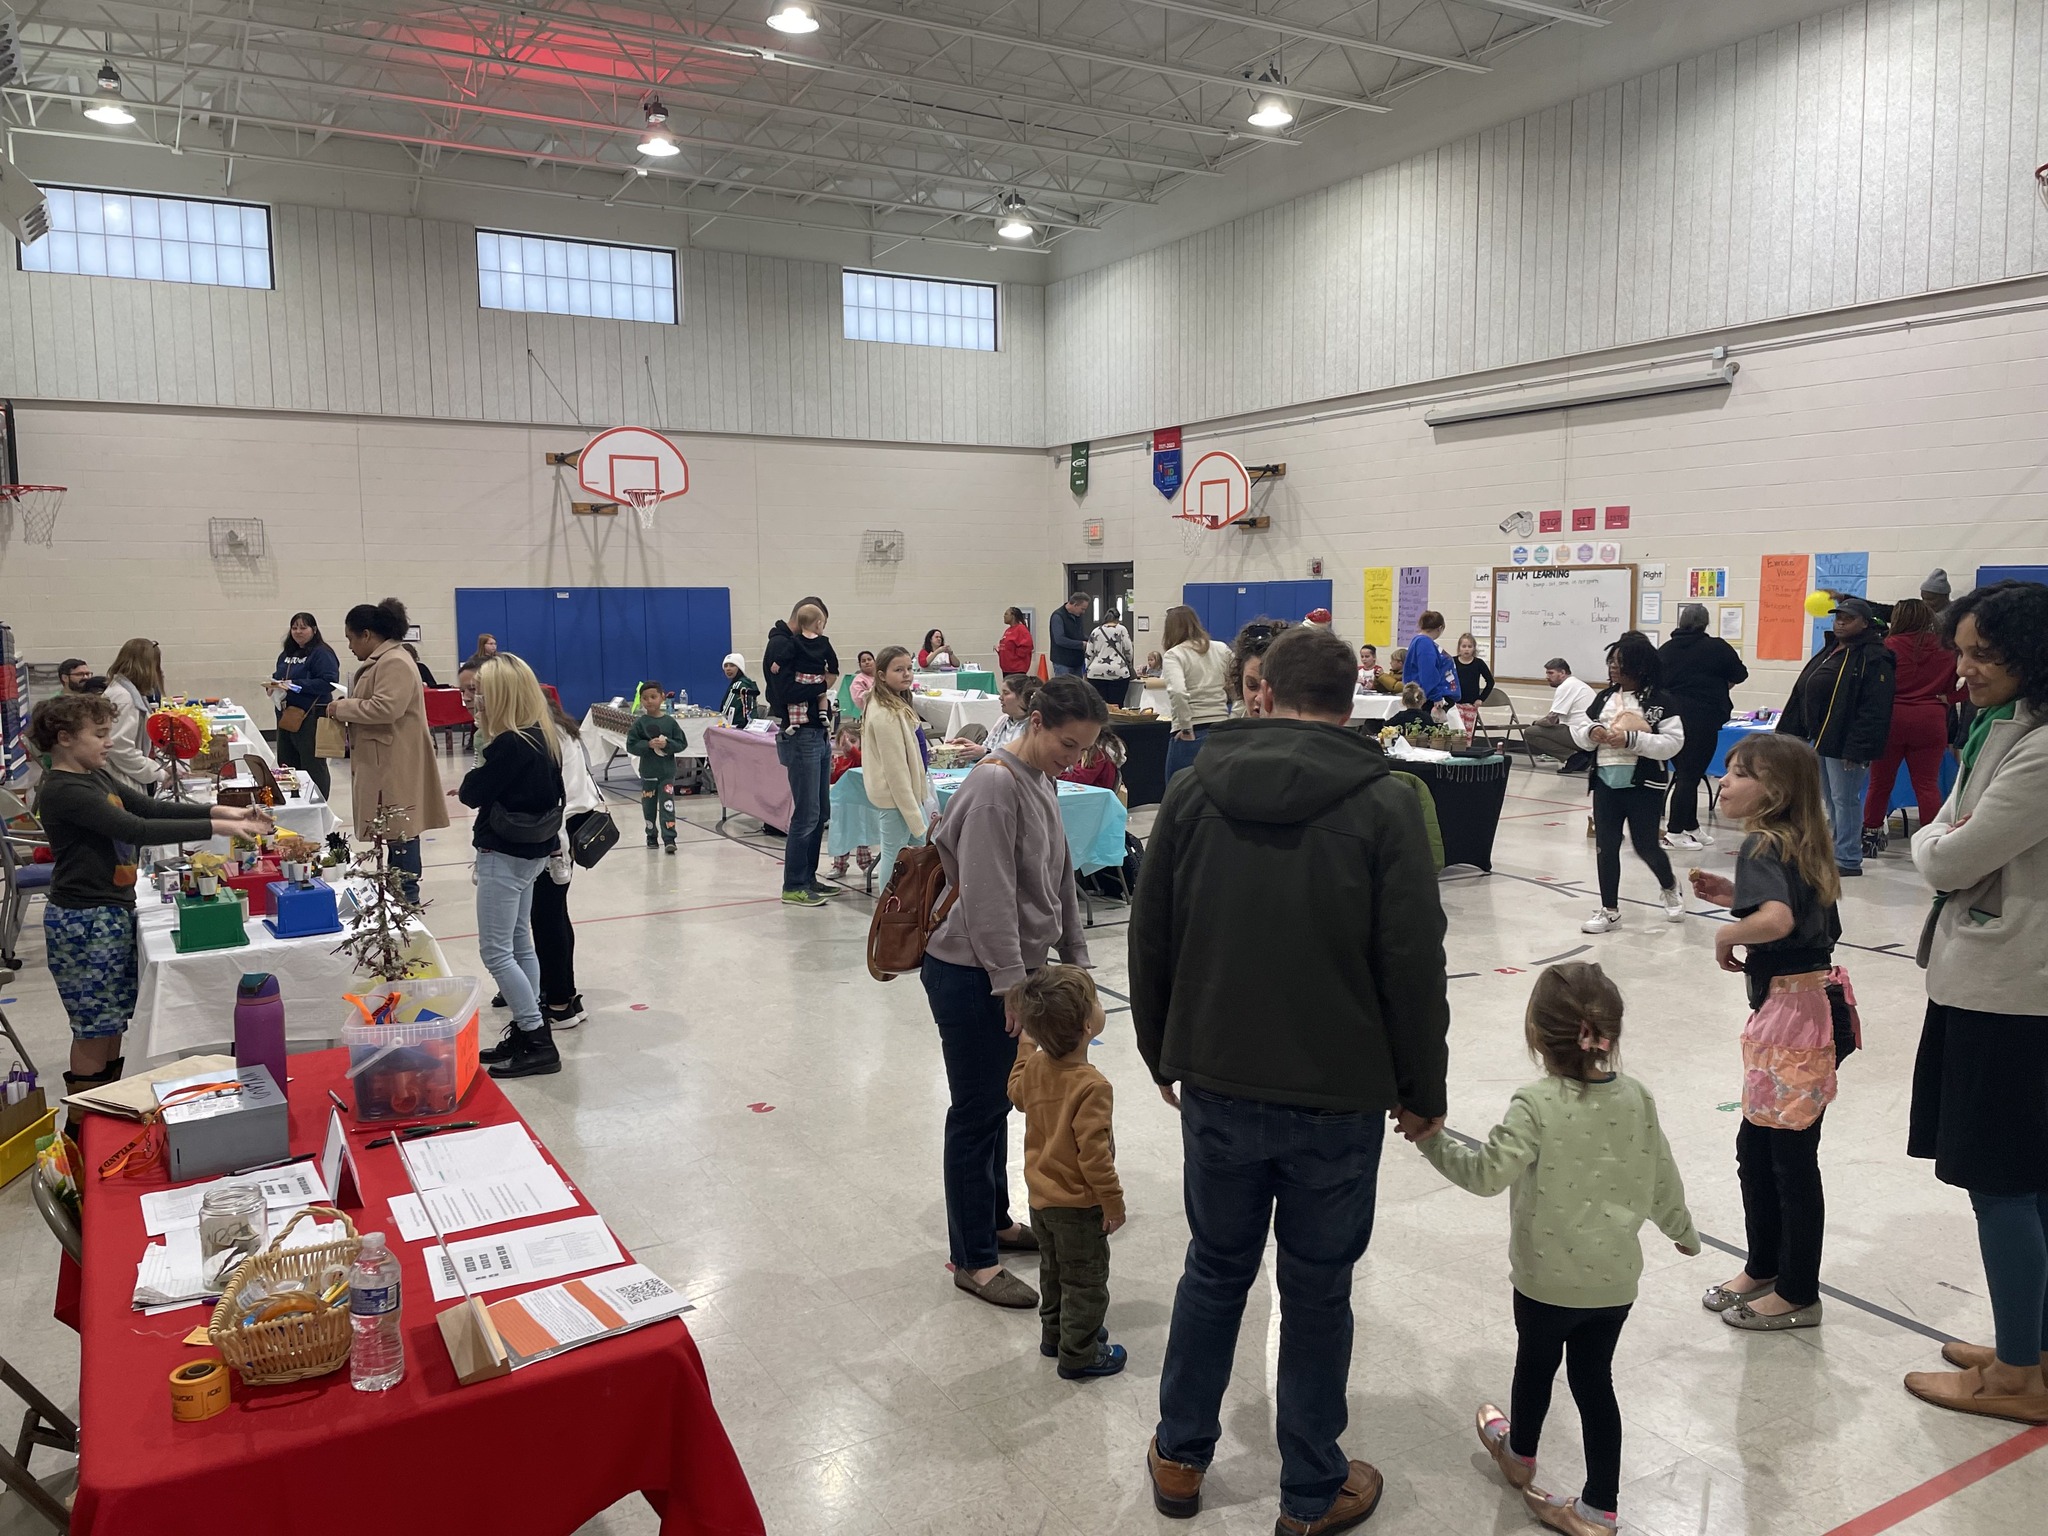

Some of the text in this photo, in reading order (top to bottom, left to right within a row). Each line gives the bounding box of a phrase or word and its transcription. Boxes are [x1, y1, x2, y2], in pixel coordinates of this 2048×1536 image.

[1541, 517, 1560, 526] STOP
[1577, 516, 1592, 525] SIT
[1607, 514, 1629, 522] LISTEN
[1476, 574, 1490, 582] Left
[1511, 572, 1514, 580] I
[1516, 571, 1528, 580] AM
[1533, 570, 1570, 579] LEARNING
[1643, 571, 1662, 580] Right
[1592, 612, 1619, 623] Education
[104, 1142, 137, 1168] WYLAND
